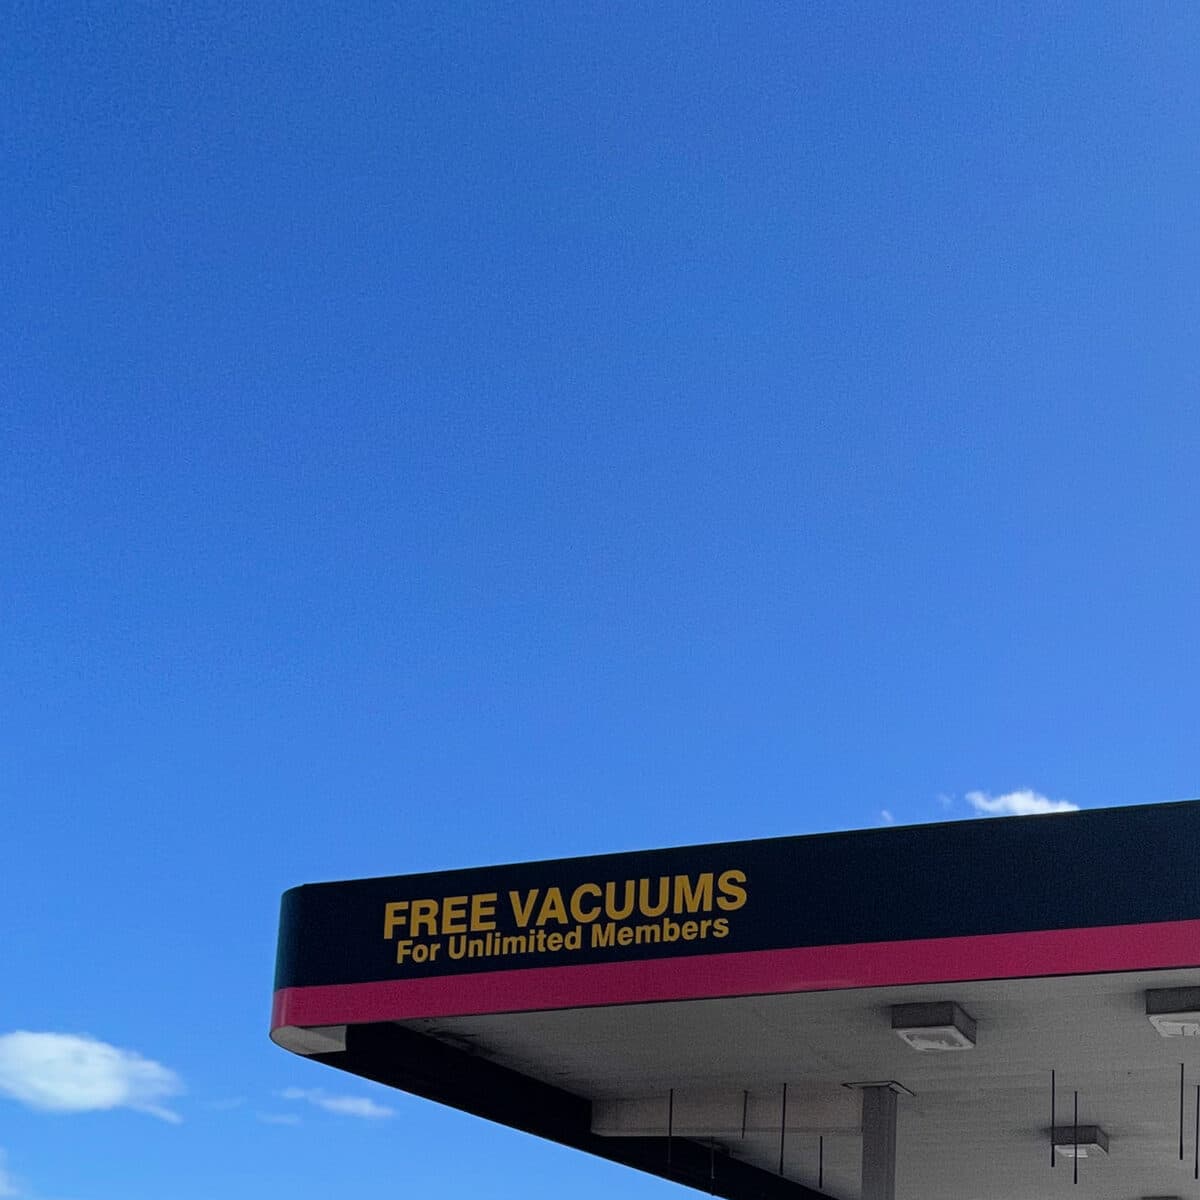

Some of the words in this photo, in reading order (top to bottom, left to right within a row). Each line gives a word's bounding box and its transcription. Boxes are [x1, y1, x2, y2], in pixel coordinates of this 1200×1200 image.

[383, 892, 498, 940] FREE
[509, 869, 748, 929] VACUUMS
[396, 939, 441, 965] For
[448, 925, 582, 961] Unlimited
[591, 916, 730, 949] Members
